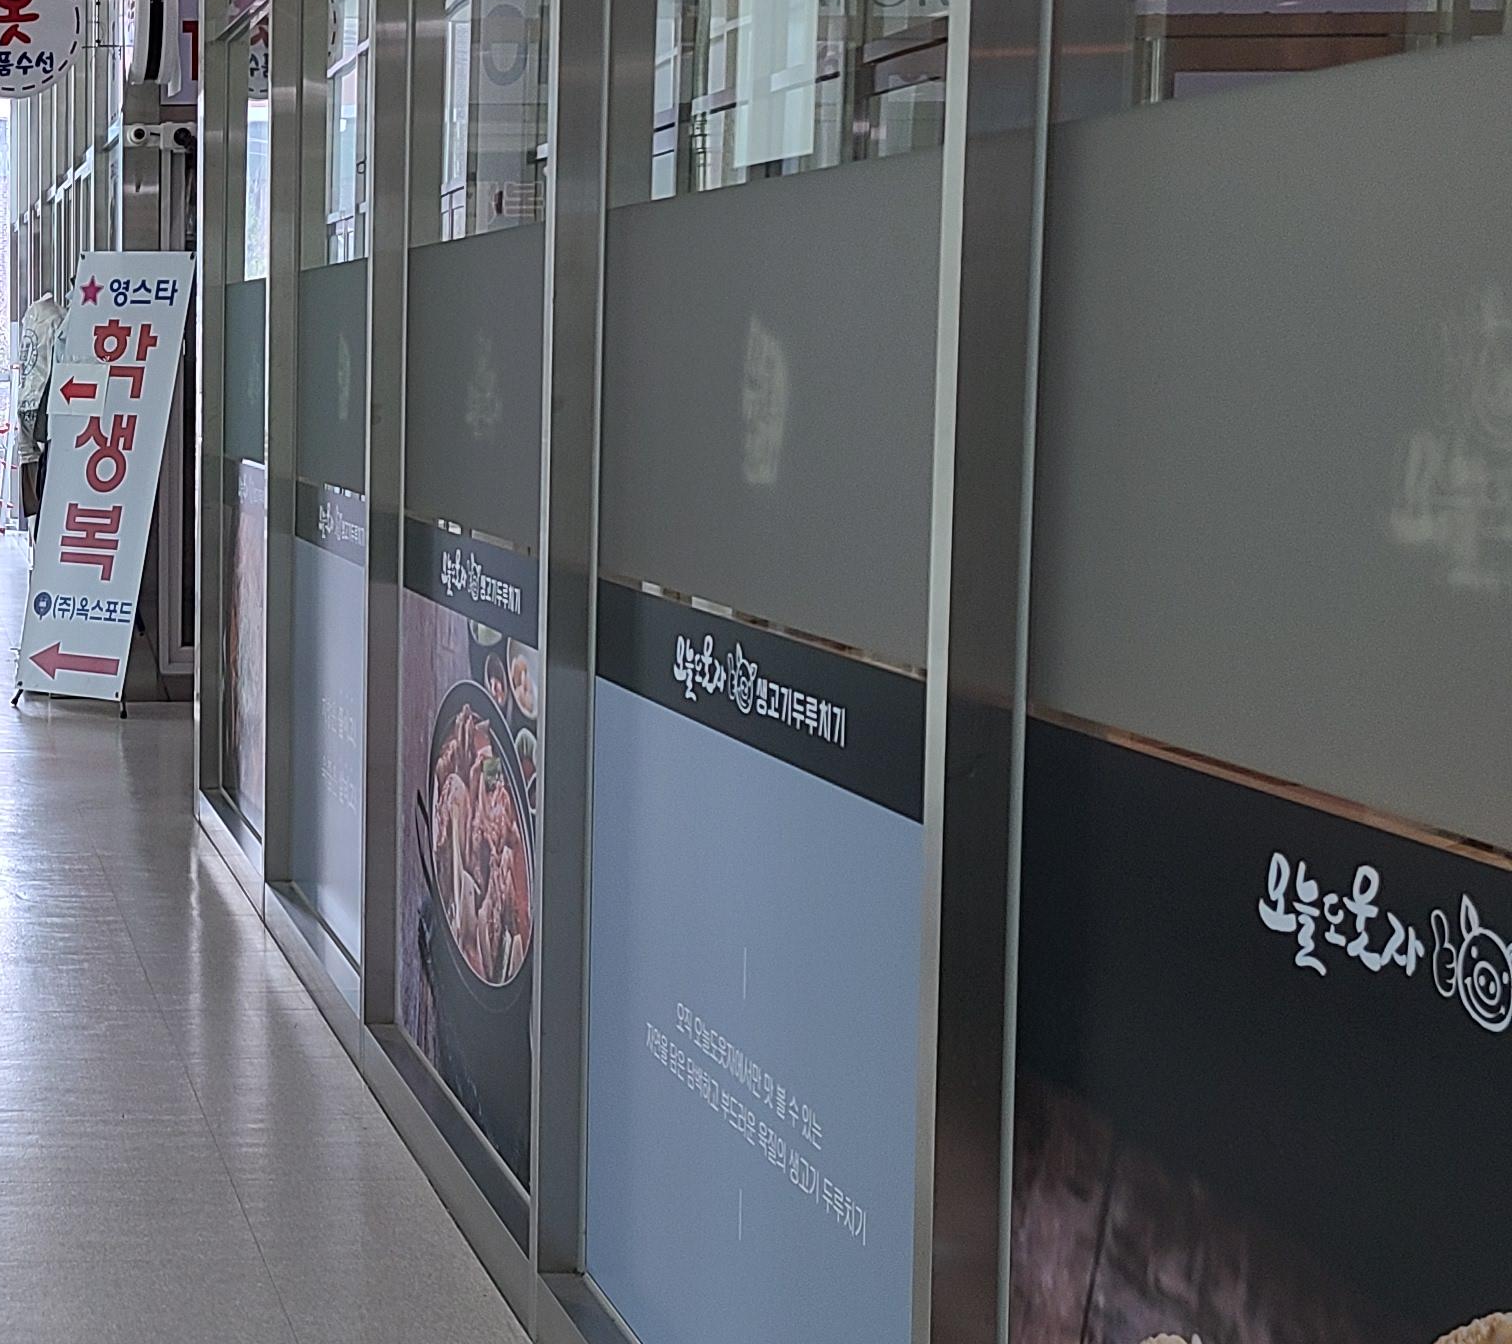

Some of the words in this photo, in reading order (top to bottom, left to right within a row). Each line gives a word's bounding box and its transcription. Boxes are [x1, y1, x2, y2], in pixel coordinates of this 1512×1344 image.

[109, 278, 179, 307] 영스타
[52, 594, 133, 624] (주)옥스포드
[755, 677, 846, 749] 생고기두루치기
[789, 1149, 819, 1205] 생고기
[822, 1177, 866, 1246] 두루치기
